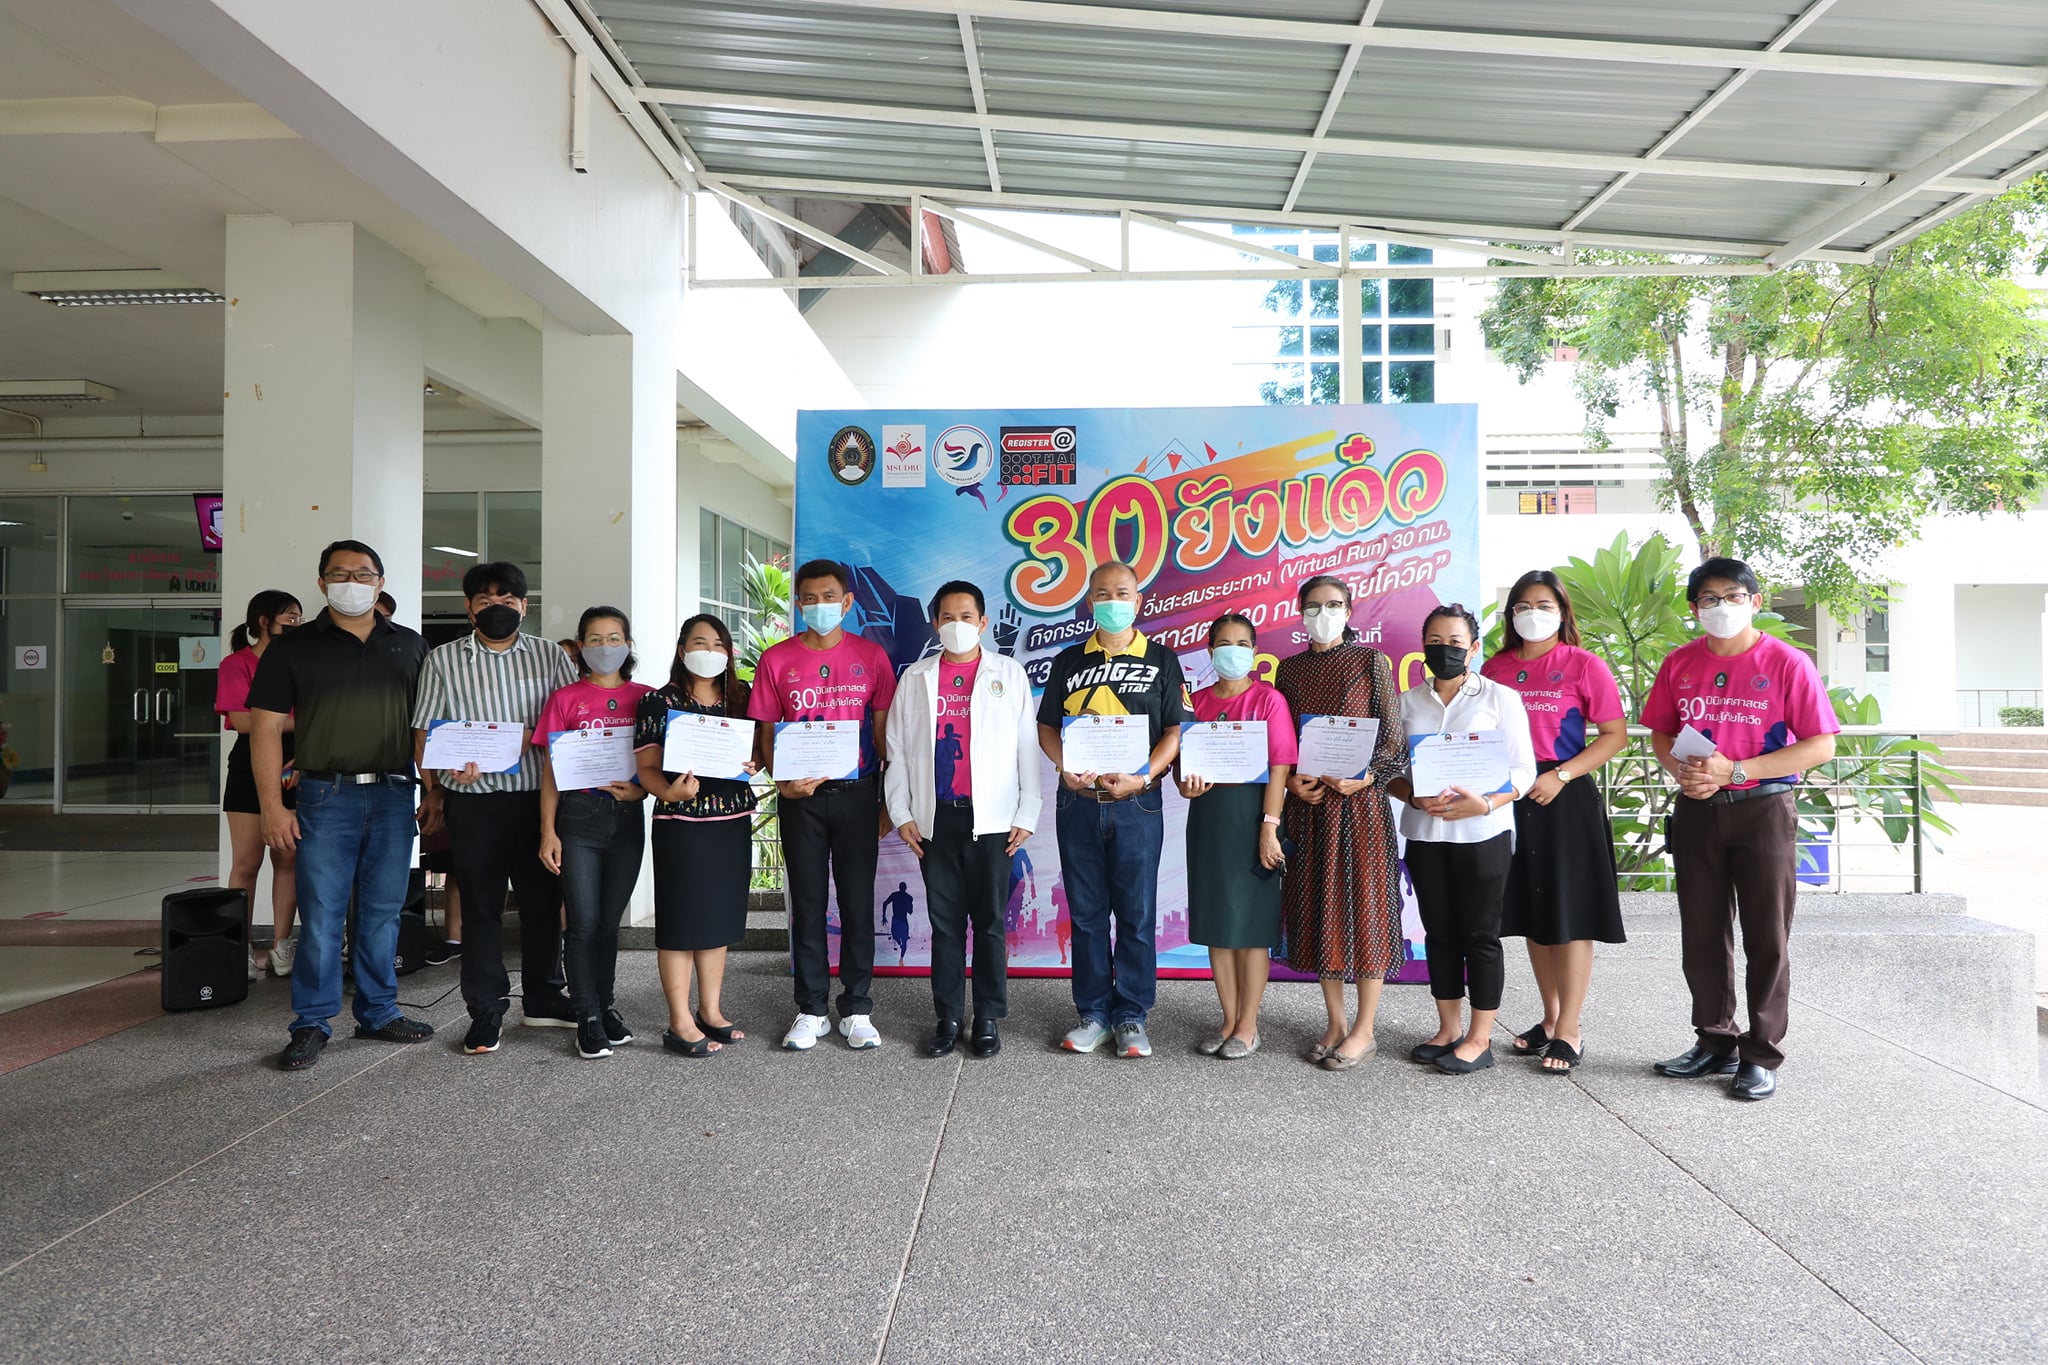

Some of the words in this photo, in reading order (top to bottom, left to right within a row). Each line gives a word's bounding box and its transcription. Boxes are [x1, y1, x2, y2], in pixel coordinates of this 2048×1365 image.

[1007, 438, 1050, 448] REGISTER
[1032, 453, 1075, 464] THAI
[1031, 464, 1075, 485] FIT
[1006, 475, 1169, 614] 30
[1030, 619, 1099, 648] กิจกรรม
[1280, 548, 1343, 584] (Virtual
[1346, 539, 1388, 562] Run)
[1391, 531, 1414, 550] 30
[1418, 524, 1448, 543] กม.
[157, 664, 176, 673] CLOSE
[789, 688, 817, 711] 30
[1678, 696, 1706, 721] 30
